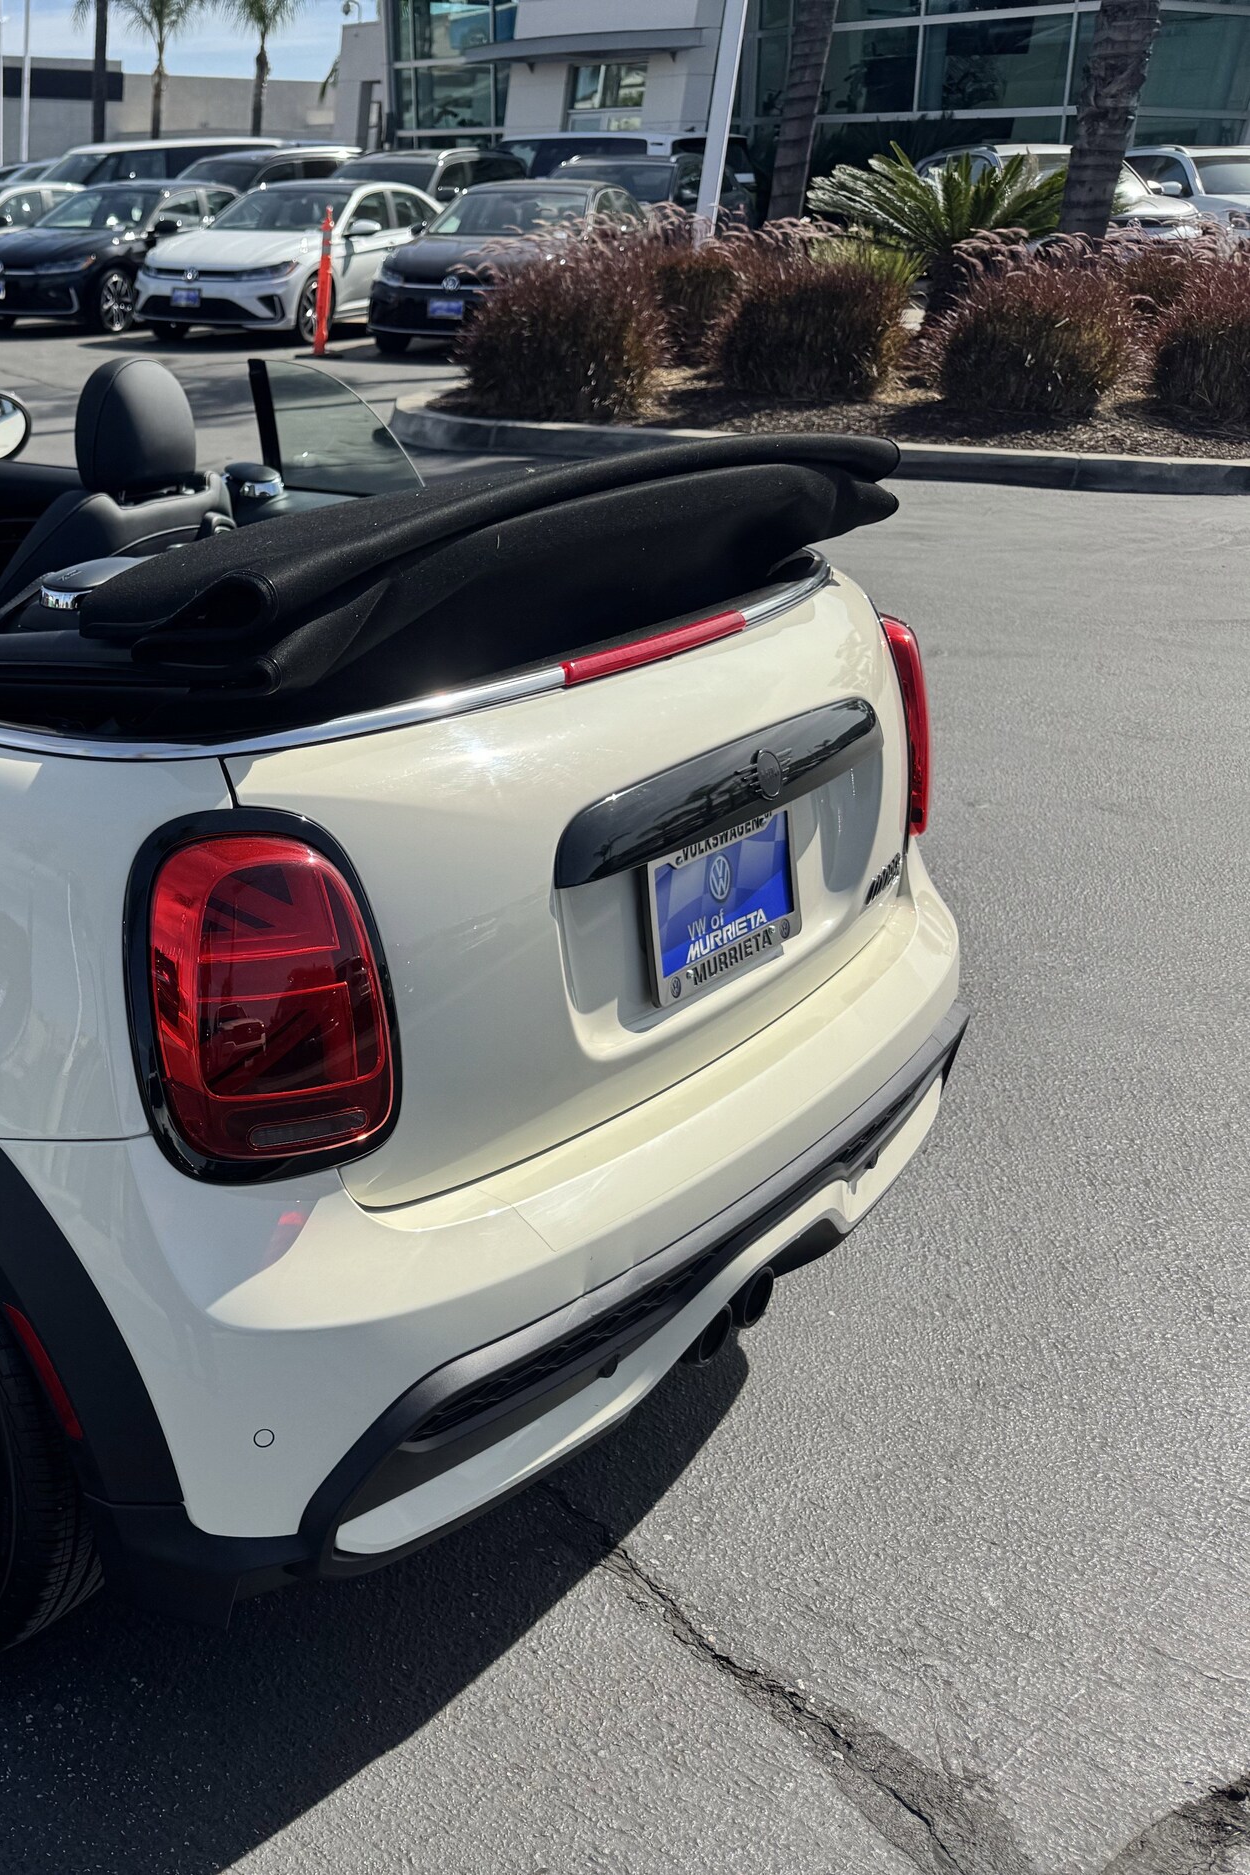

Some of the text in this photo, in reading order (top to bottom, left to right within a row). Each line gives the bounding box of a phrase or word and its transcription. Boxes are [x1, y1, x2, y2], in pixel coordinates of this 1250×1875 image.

[681, 819, 761, 861] VOLKSWAGEN
[686, 908, 768, 964] MURRIETA
[687, 908, 724, 941] VW of
[692, 928, 773, 986] MURRIETA
